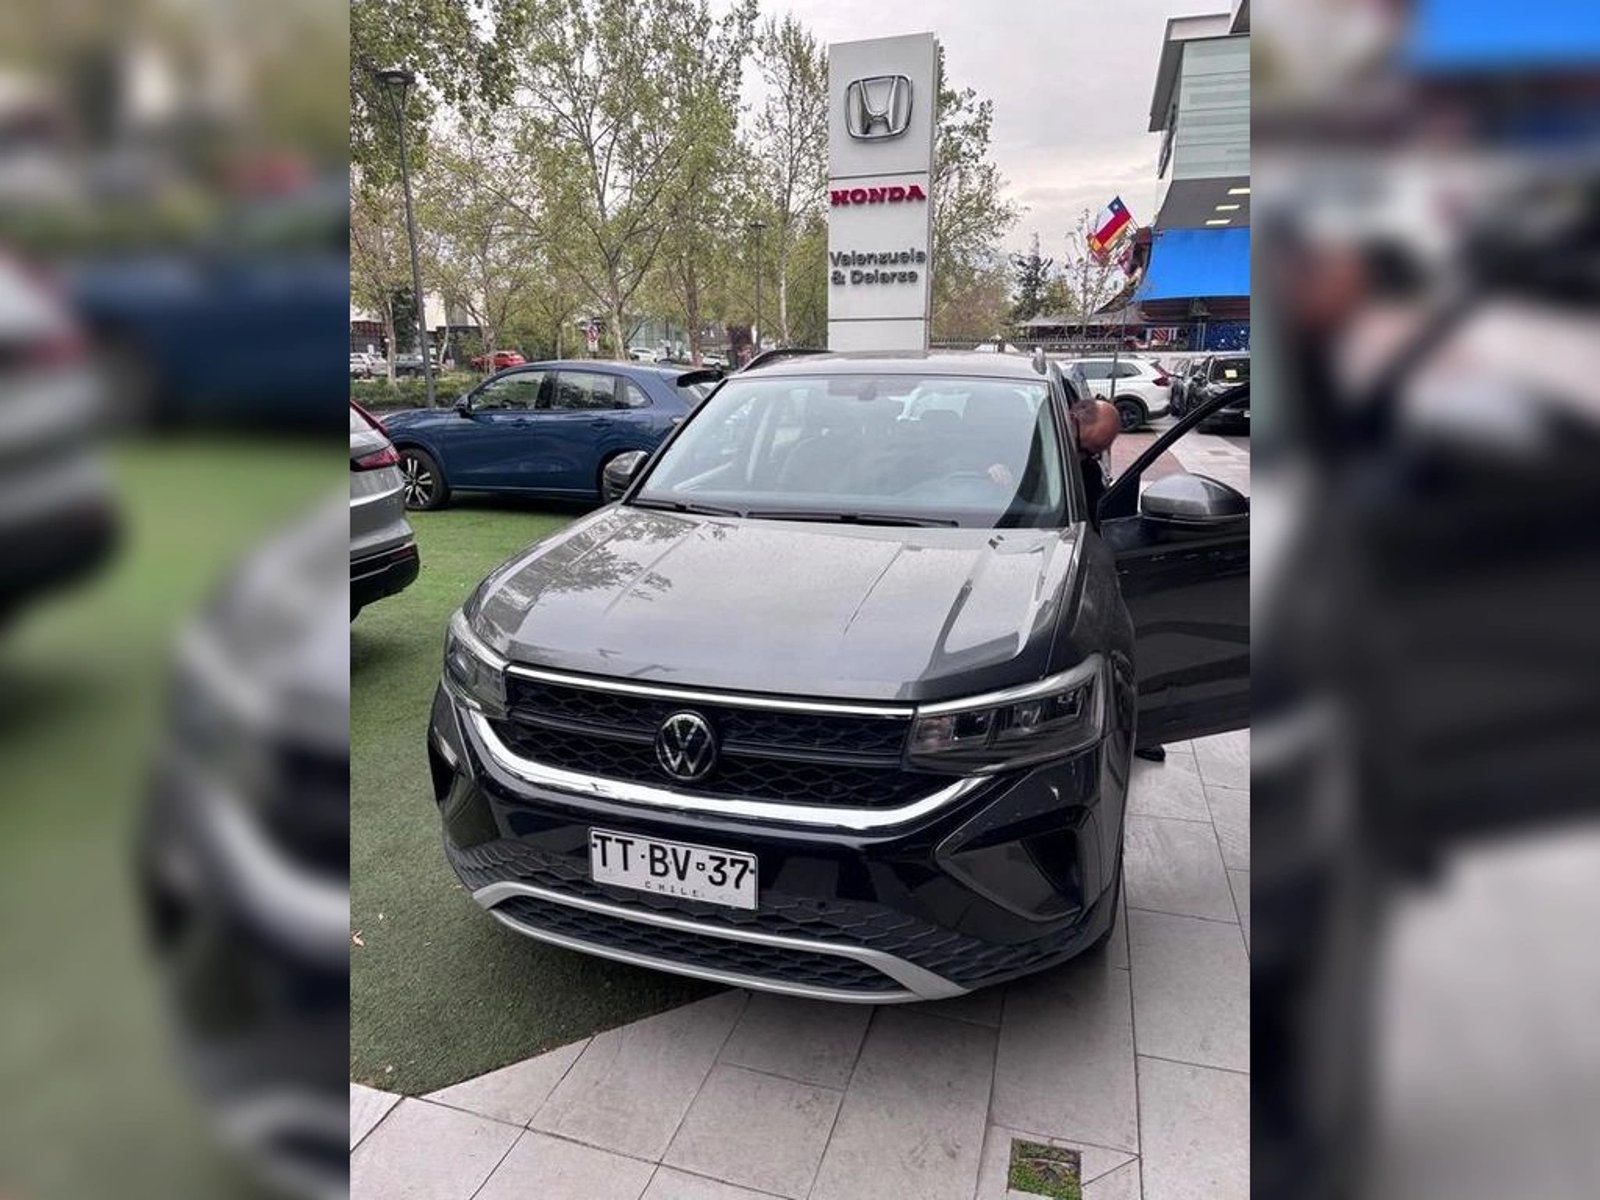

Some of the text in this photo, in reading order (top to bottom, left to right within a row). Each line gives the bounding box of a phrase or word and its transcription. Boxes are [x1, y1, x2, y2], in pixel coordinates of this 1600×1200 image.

[830, 185, 926, 206] HONDA
[829, 248, 926, 267] Valenzuela
[831, 270, 846, 285] &
